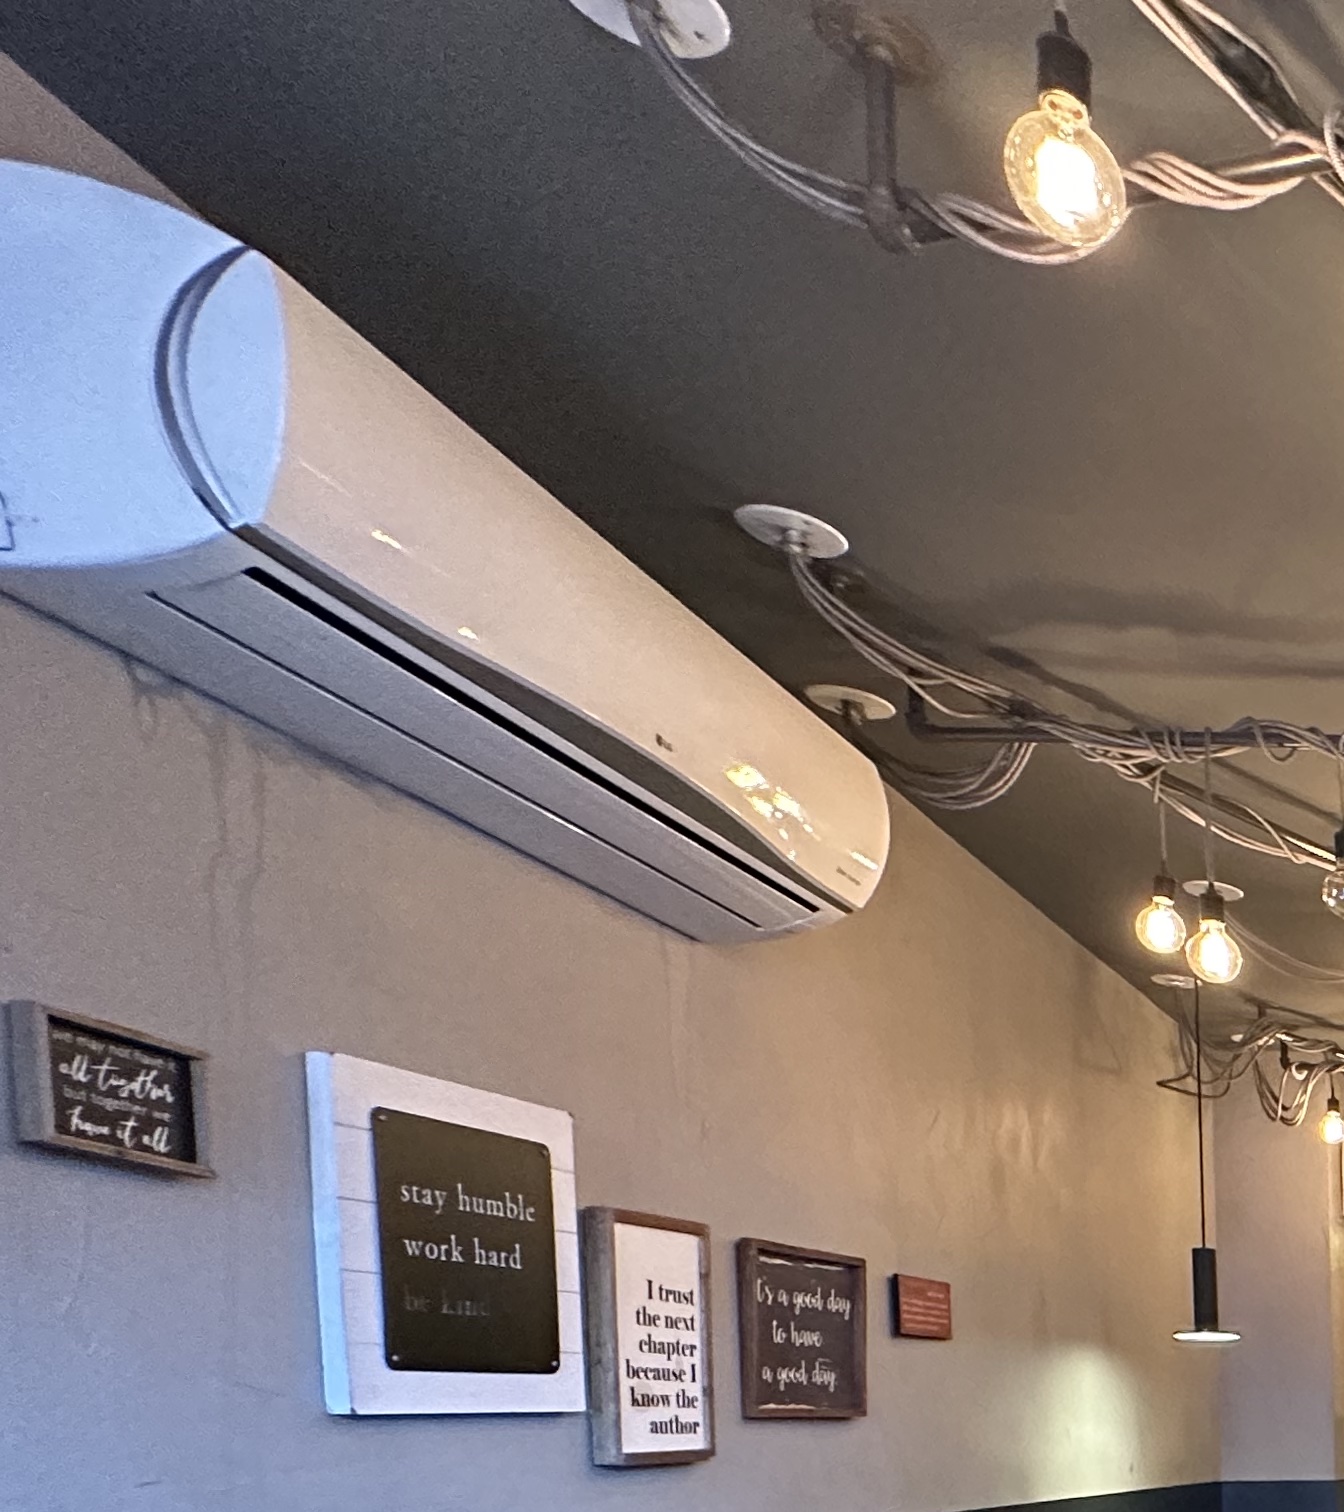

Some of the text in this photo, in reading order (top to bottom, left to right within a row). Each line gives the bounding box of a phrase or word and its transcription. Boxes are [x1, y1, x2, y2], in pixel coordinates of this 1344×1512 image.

[58, 1054, 92, 1083] all
[142, 1126, 172, 1154] all
[400, 1182, 536, 1222] stay humble
[402, 1234, 523, 1270] work hard
[646, 1279, 695, 1307] I trust
[777, 1289, 789, 1307] a
[792, 1286, 823, 1315] good
[826, 1288, 851, 1320] day
[635, 1305, 695, 1332] the next
[638, 1333, 697, 1361] chapter
[772, 1319, 822, 1347] to have
[625, 1358, 697, 1383] because I
[762, 1366, 773, 1383] a
[777, 1360, 808, 1391] good
[629, 1386, 699, 1409] know the
[649, 1414, 700, 1435] author
